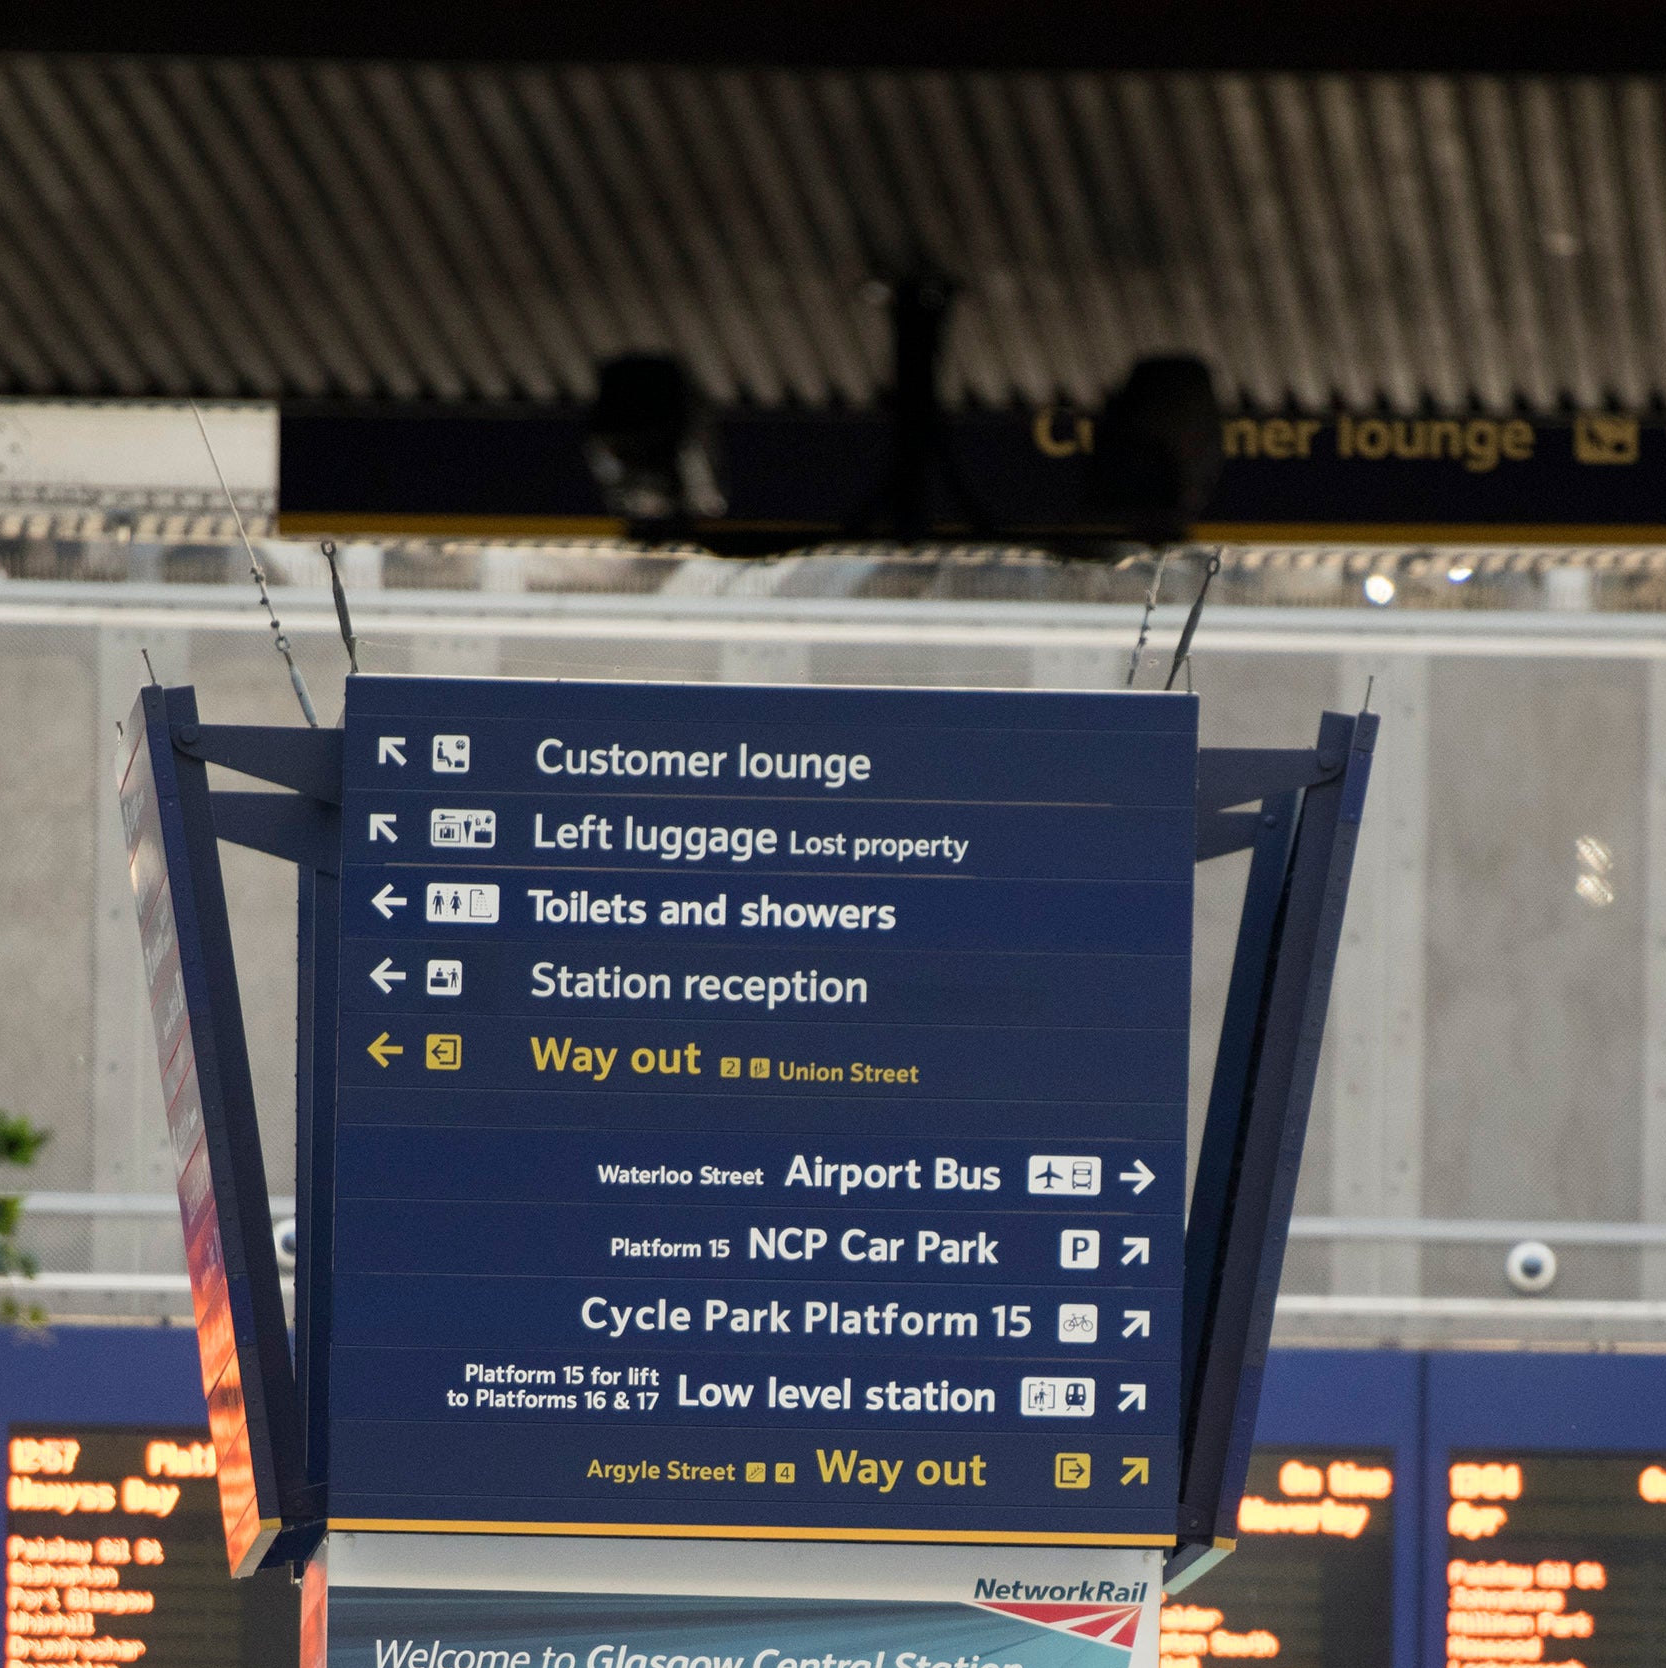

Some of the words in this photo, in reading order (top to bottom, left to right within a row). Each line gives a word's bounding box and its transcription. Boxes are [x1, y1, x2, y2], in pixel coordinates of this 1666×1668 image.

[536, 738, 728, 777] Customer
[739, 743, 871, 788] lounge
[534, 813, 613, 850] Left
[625, 815, 778, 862] luggage
[790, 830, 847, 855] Lost
[854, 835, 969, 863] property
[527, 889, 647, 925] Toilets
[659, 893, 727, 926] and
[740, 894, 896, 930] showers
[531, 961, 671, 999] Station
[684, 969, 867, 1010] reception
[530, 1037, 618, 1081] Way
[631, 1042, 701, 1075] out
[779, 1061, 844, 1081] Union
[850, 1062, 919, 1083] Street
[597, 1164, 693, 1185] Waterloo
[700, 1165, 764, 1186] Street
[784, 1154, 922, 1196] Airport
[934, 1157, 1001, 1191] Bus
[611, 1237, 702, 1258] Platform
[708, 1239, 730, 1258] 15
[749, 1227, 828, 1261] NCP
[840, 1228, 905, 1262] Car
[917, 1230, 999, 1264] Park
[581, 1296, 691, 1338] Cycle
[705, 1299, 791, 1333] Park
[804, 1301, 978, 1337] Platform
[991, 1305, 1032, 1338] 15
[465, 1363, 556, 1385] Platform
[562, 1365, 585, 1385] 15
[590, 1366, 622, 1386] for
[628, 1366, 660, 1387] lift
[678, 1374, 755, 1408] Low
[768, 1376, 852, 1410] level
[865, 1380, 996, 1413] station
[446, 1389, 469, 1407] to
[476, 1388, 578, 1409] Platforms
[584, 1390, 607, 1410] 16
[613, 1391, 631, 1410] &
[636, 1391, 660, 1411] 17
[586, 1459, 661, 1483] Argyle
[667, 1460, 736, 1481] Street
[816, 1449, 904, 1493] Way
[916, 1454, 987, 1487] out
